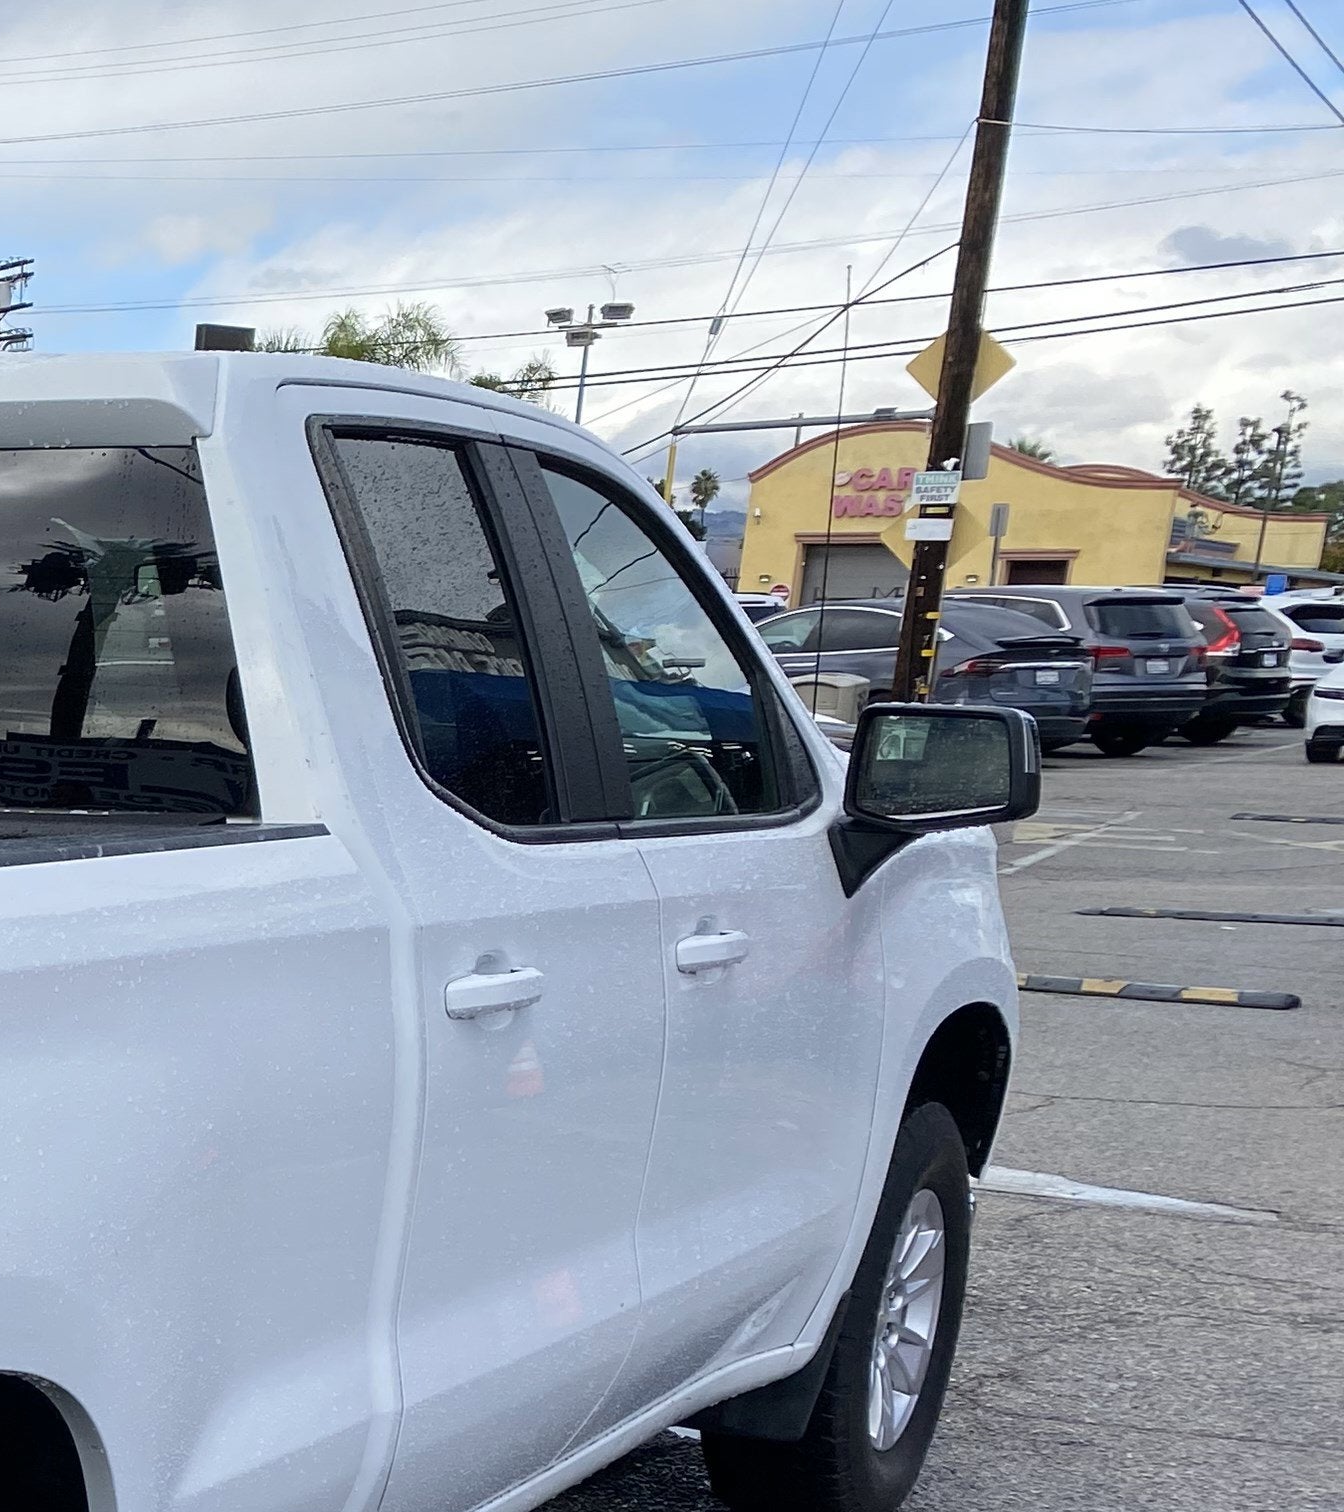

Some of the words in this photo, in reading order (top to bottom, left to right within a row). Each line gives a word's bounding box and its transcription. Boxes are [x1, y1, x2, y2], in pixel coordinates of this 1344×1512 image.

[918, 475, 958, 485] THINK
[915, 485, 956, 494] SAFETY
[920, 494, 950, 502] FIRST
[833, 494, 904, 518] WAS
